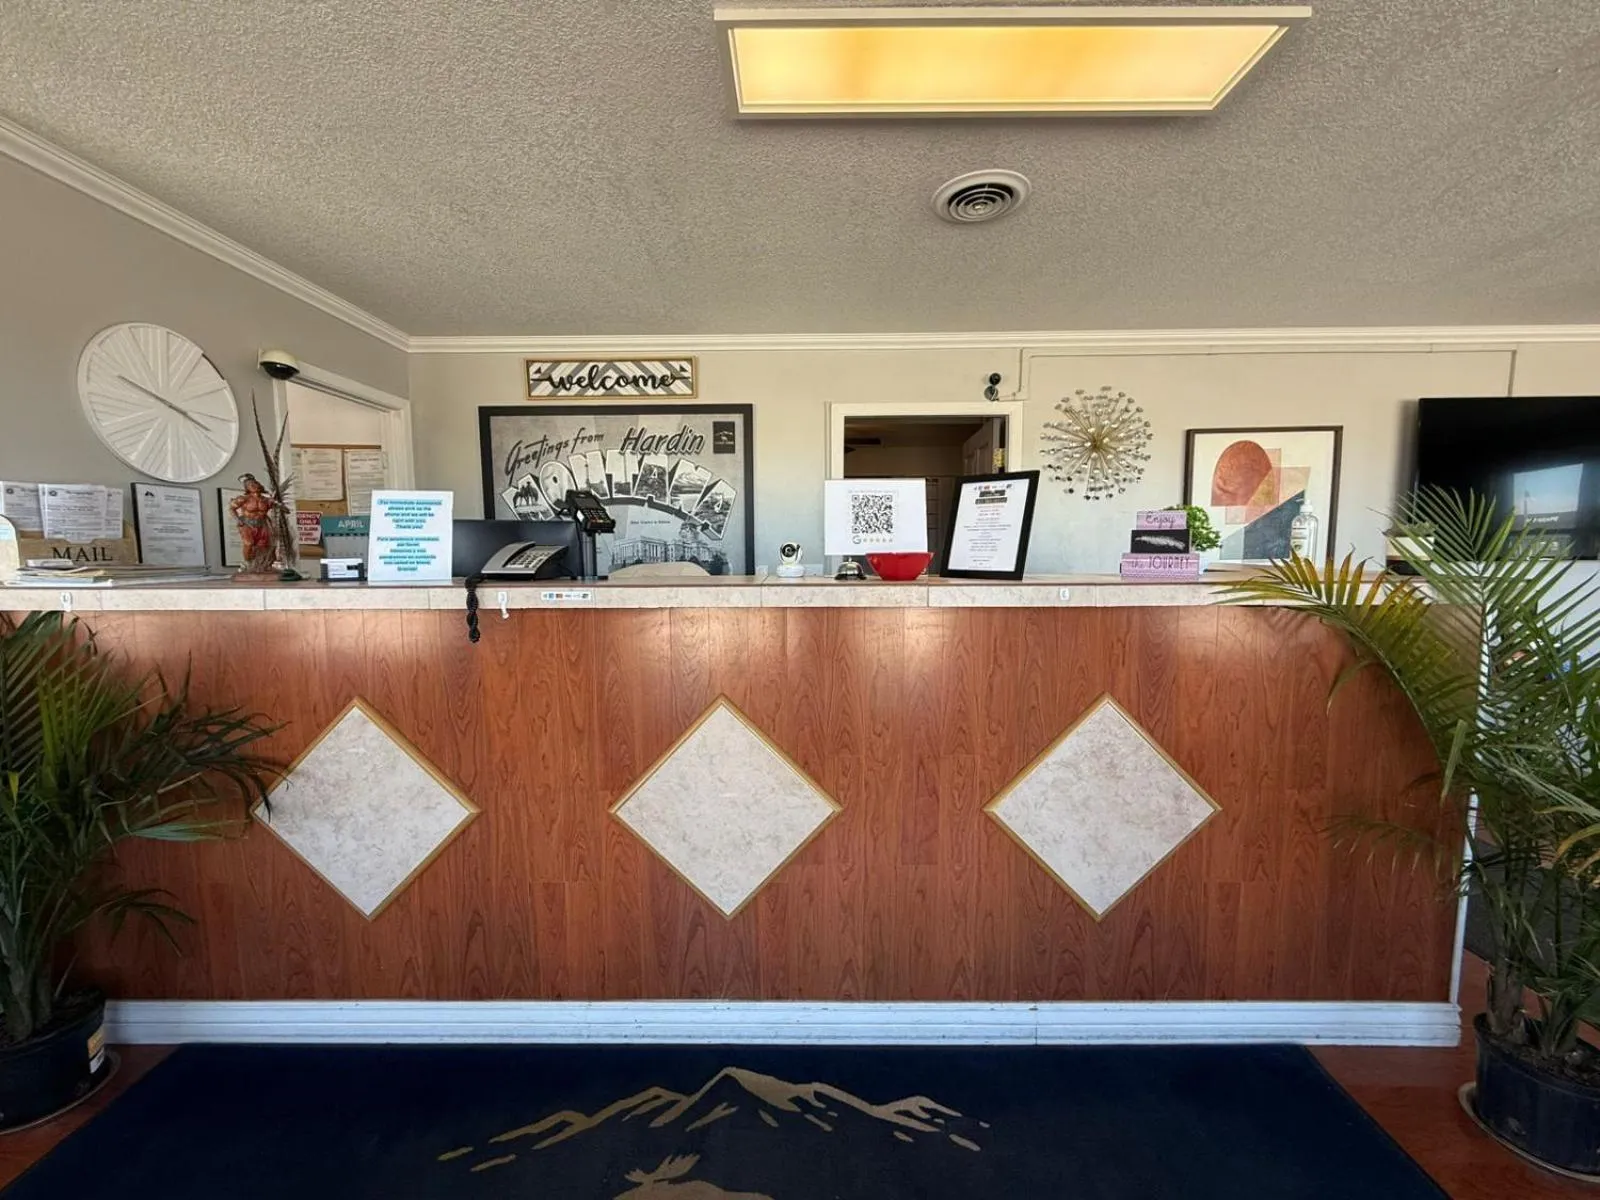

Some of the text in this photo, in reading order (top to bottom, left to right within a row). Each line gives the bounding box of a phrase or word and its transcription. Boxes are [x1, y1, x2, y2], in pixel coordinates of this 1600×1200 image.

[547, 364, 677, 391] welcome
[618, 424, 705, 457] Hardin
[505, 427, 605, 486] Greetings from
[338, 519, 365, 529] APRIL
[1145, 511, 1176, 529] Enjoy
[52, 546, 113, 562] MAIL
